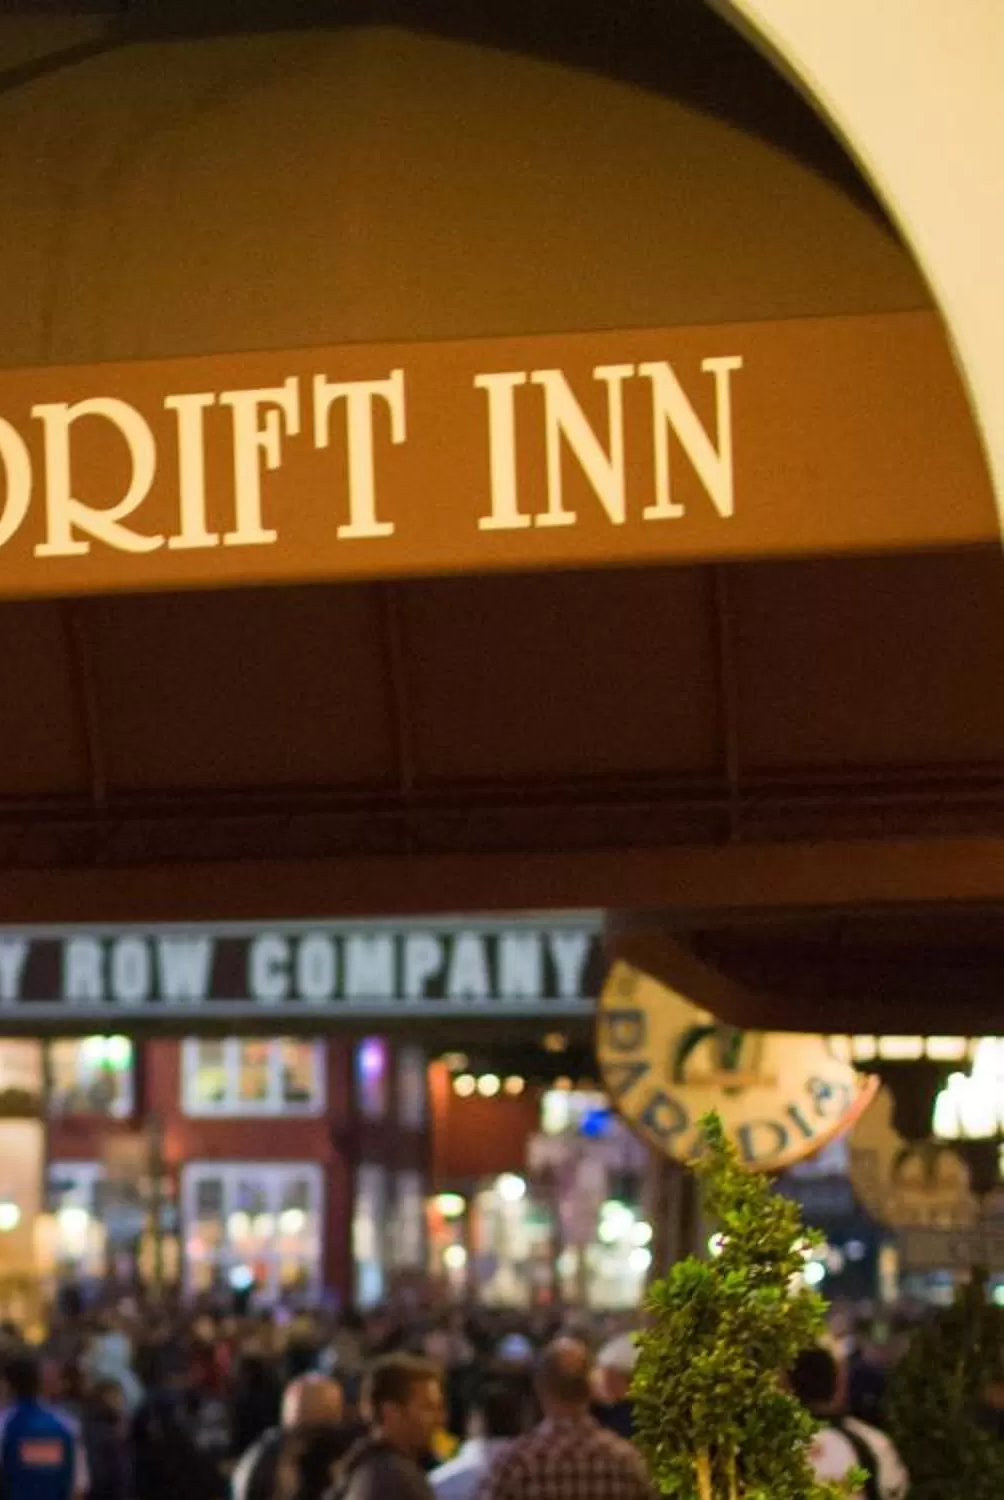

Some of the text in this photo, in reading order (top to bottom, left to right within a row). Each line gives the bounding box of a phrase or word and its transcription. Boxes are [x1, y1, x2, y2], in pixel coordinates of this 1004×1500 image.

[474, 355, 743, 530] INN
[63, 935, 214, 1004] ROW
[248, 929, 590, 1004] COMPANY
